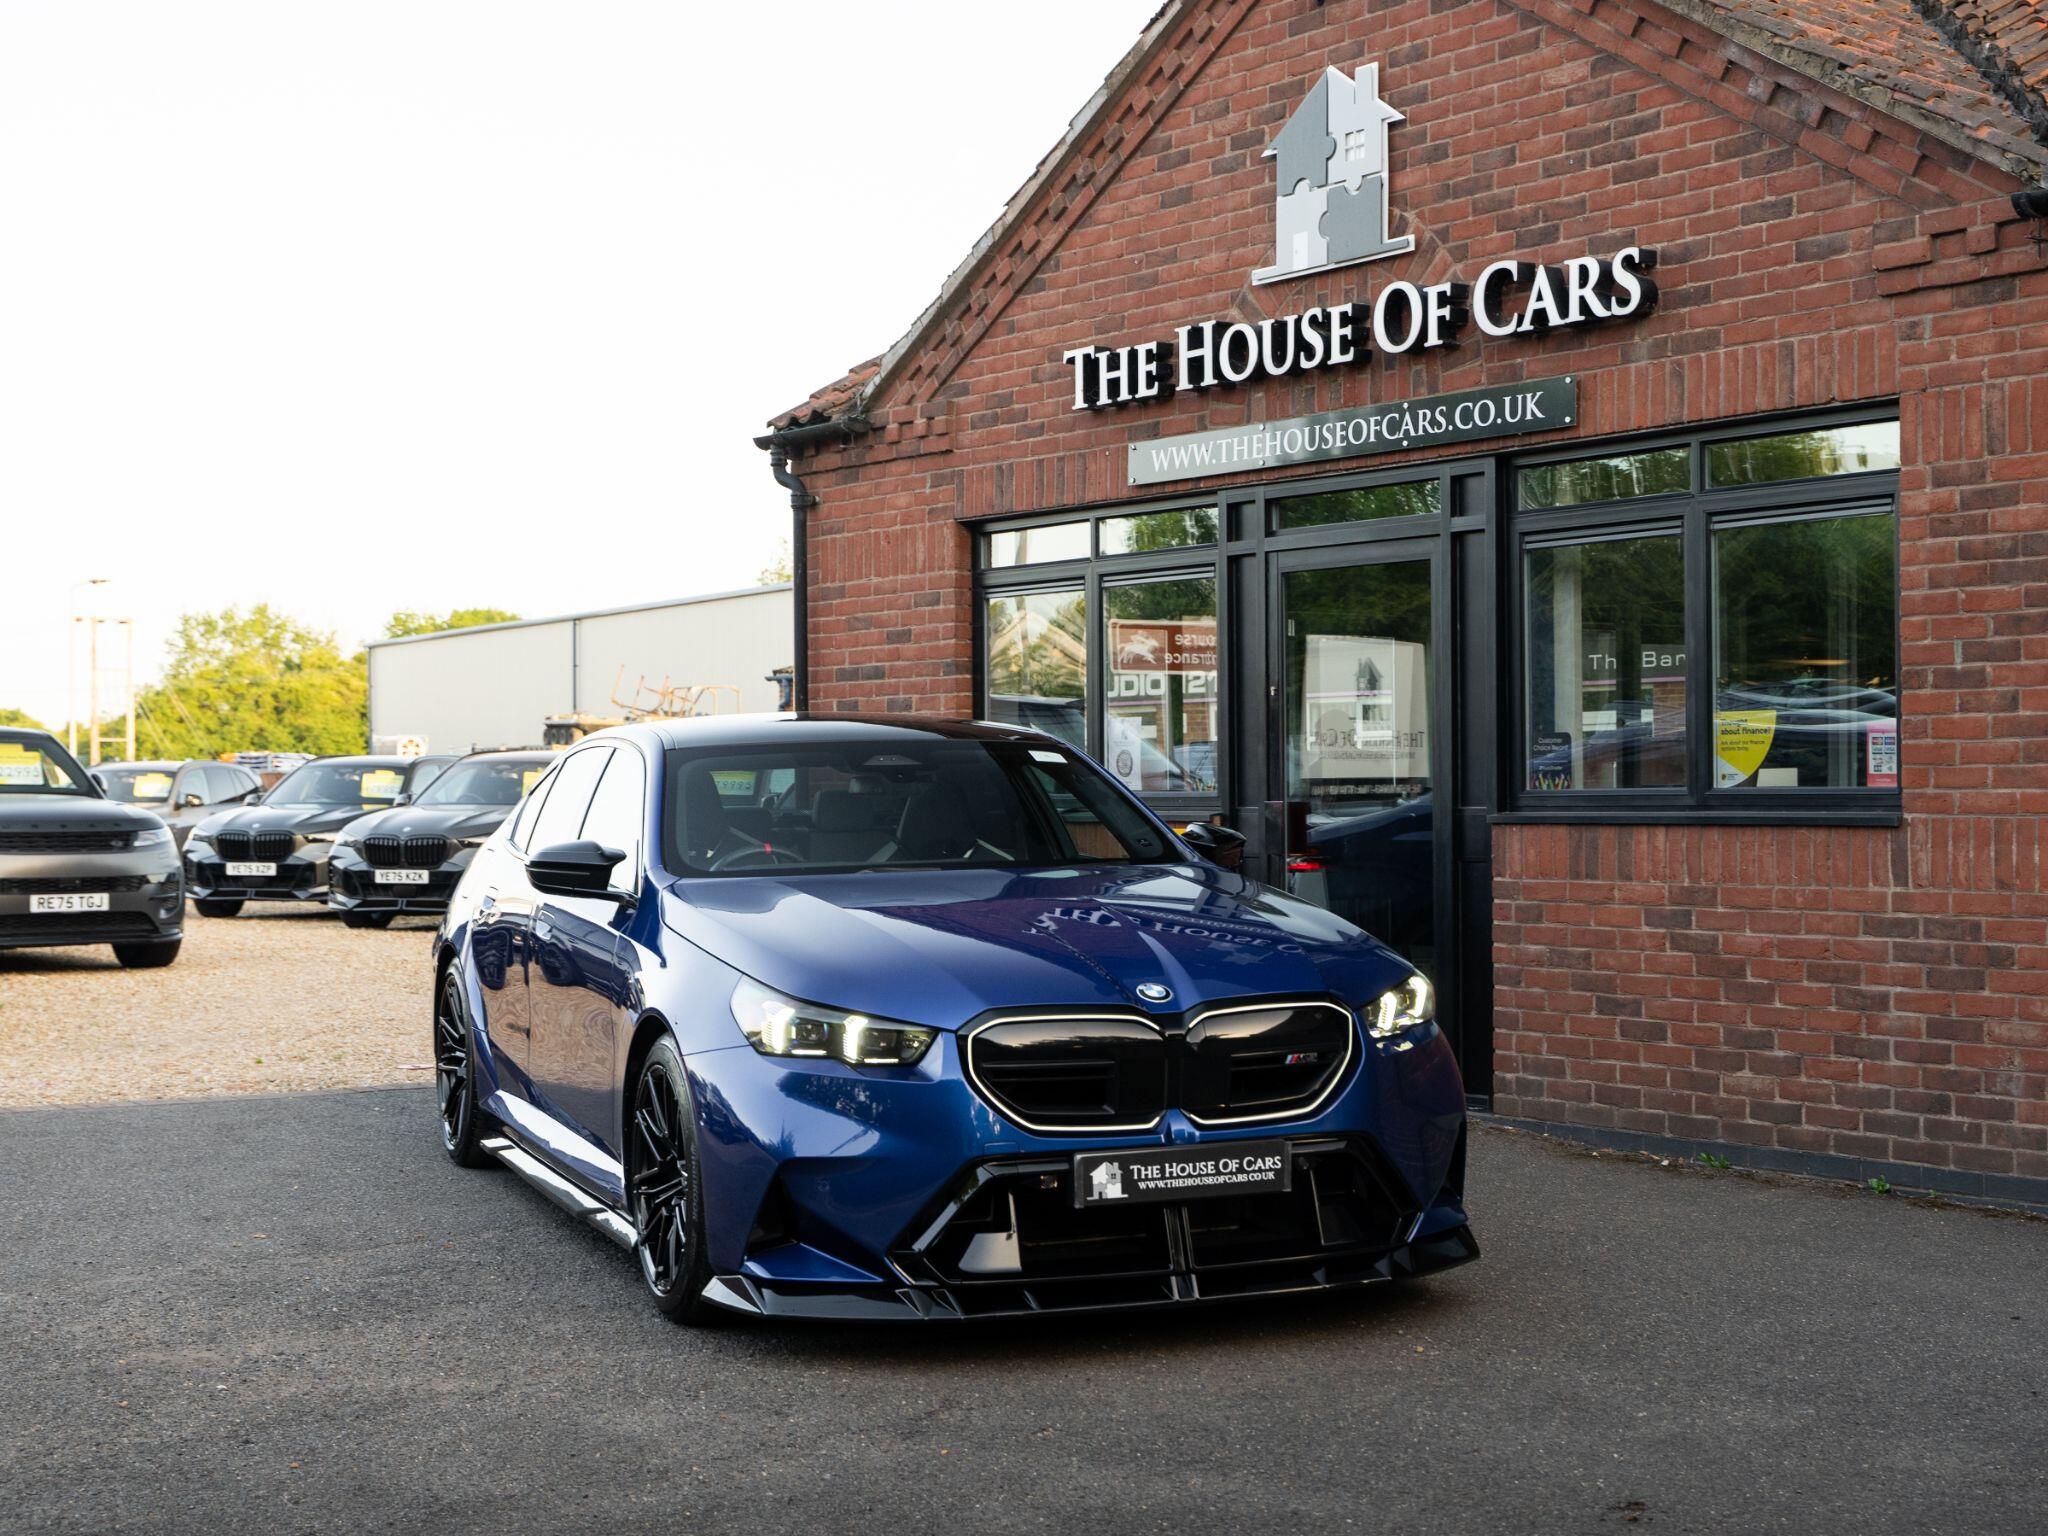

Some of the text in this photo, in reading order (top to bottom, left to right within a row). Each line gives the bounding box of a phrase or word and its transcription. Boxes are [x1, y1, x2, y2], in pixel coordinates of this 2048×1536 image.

[1063, 247, 1642, 411] THE HOUSE OF CARS
[1150, 391, 1545, 473] WWW.THEHOUSEOFCARS.CO.UK
[37, 896, 103, 909] RE75 TGJ
[1130, 1156, 1282, 1180] THE HOUSE OF CARS
